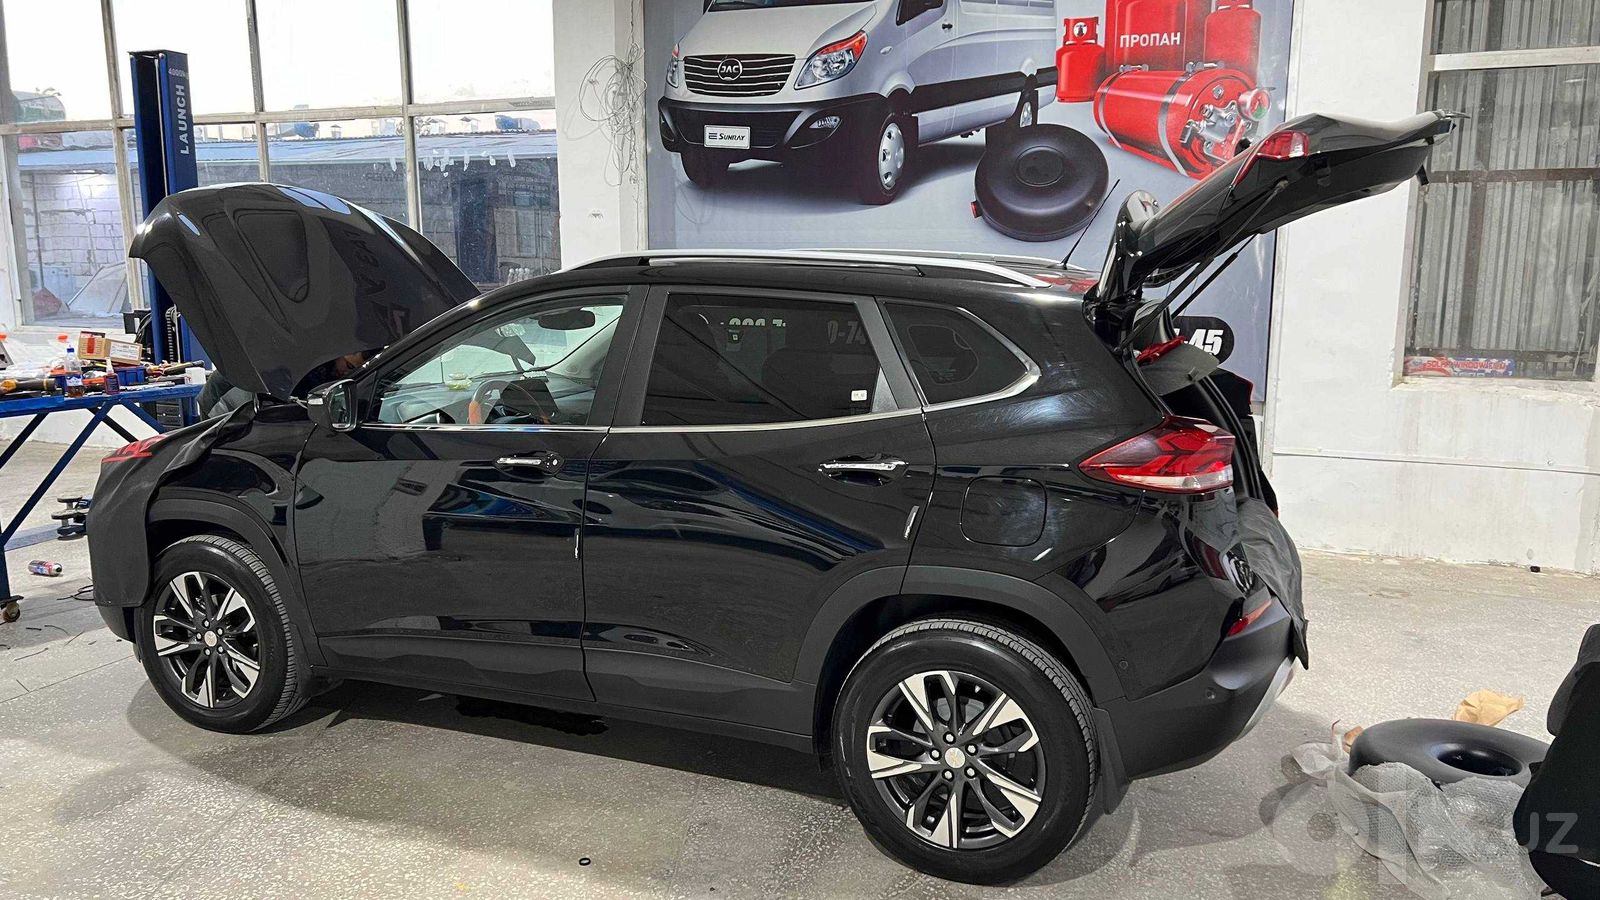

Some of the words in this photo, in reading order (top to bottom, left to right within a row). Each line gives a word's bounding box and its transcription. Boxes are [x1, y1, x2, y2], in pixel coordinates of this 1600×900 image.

[1119, 31, 1181, 48] ПРОПАН
[720, 65, 739, 73] JAC
[175, 84, 190, 155] LAUNCH
